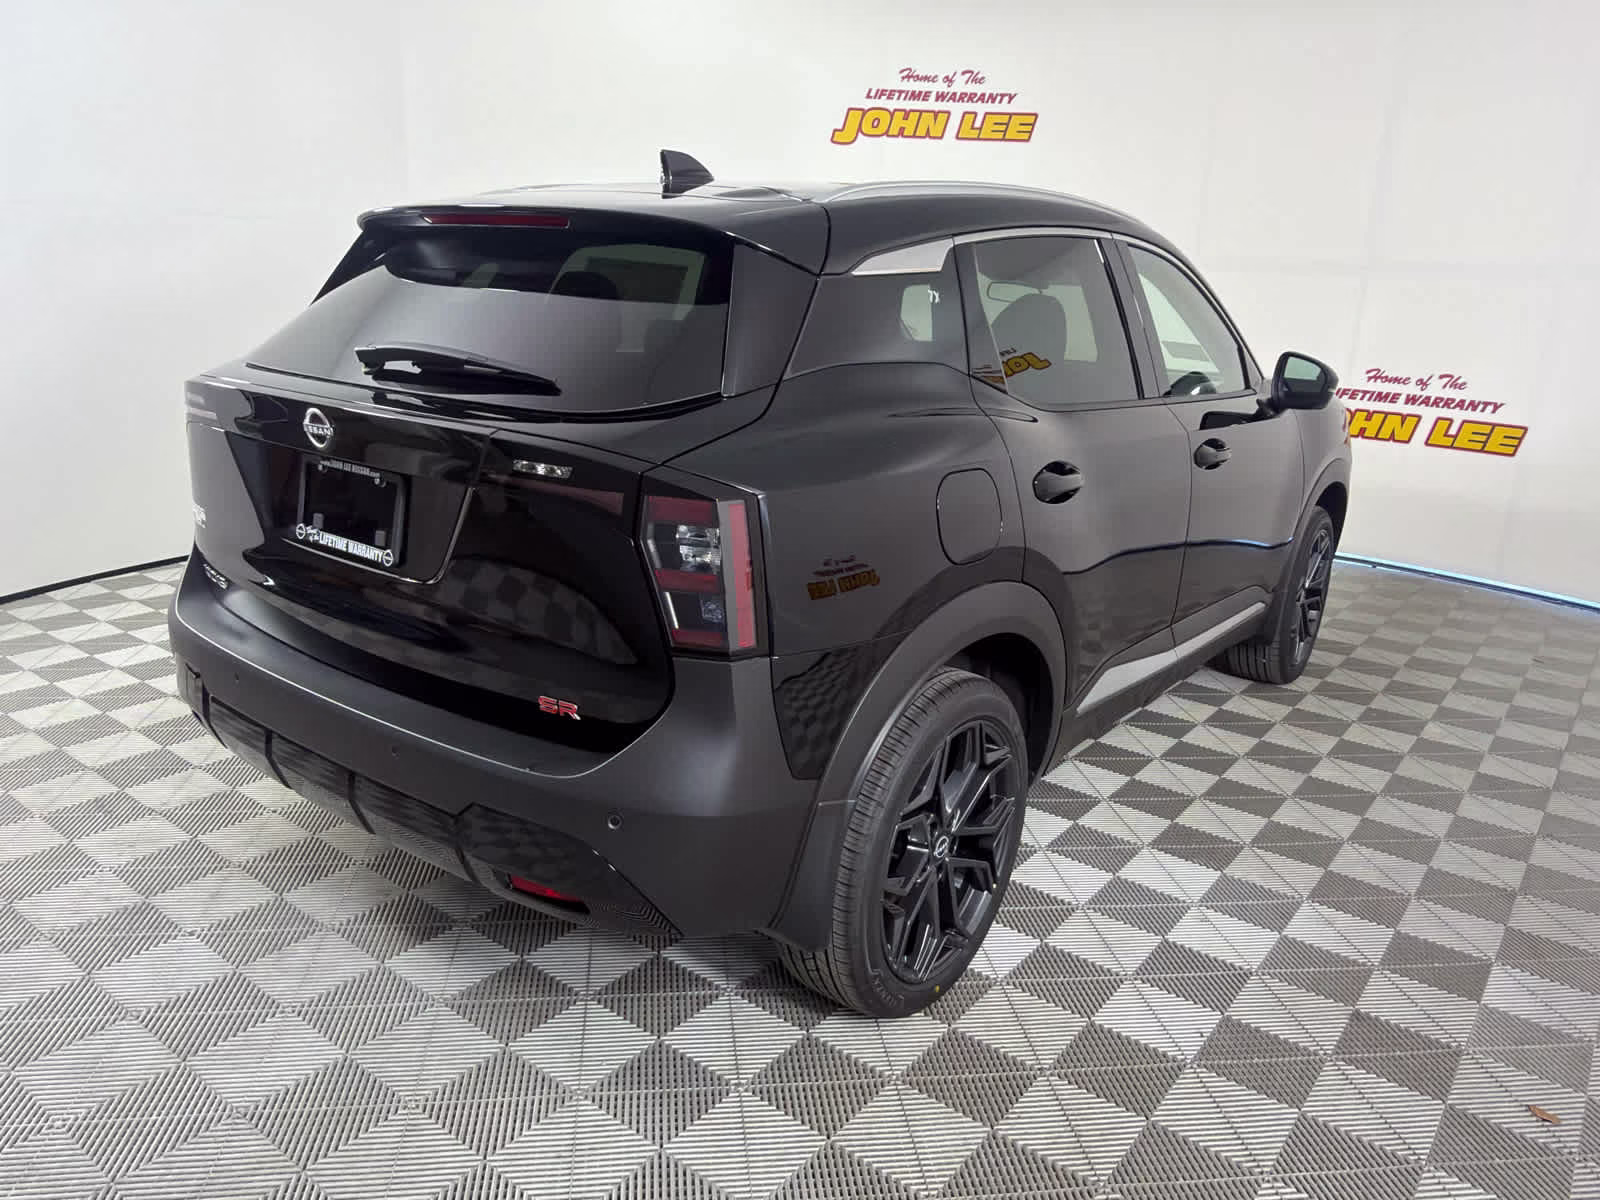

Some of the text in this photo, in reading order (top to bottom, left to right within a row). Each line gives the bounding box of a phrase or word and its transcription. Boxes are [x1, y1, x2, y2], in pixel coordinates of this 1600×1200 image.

[899, 67, 986, 88] Home of The
[865, 88, 1018, 105] LIFETIME WARRANTY
[831, 107, 1039, 145] JOHN LEE
[1365, 368, 1468, 391] Home of The
[1335, 387, 1506, 414] IFETIME WARRANTY
[1344, 408, 1529, 457] HN LEE
[320, 531, 347, 552] LIFETIME
[347, 538, 383, 562] WARRANTY
[538, 696, 581, 720] SR
